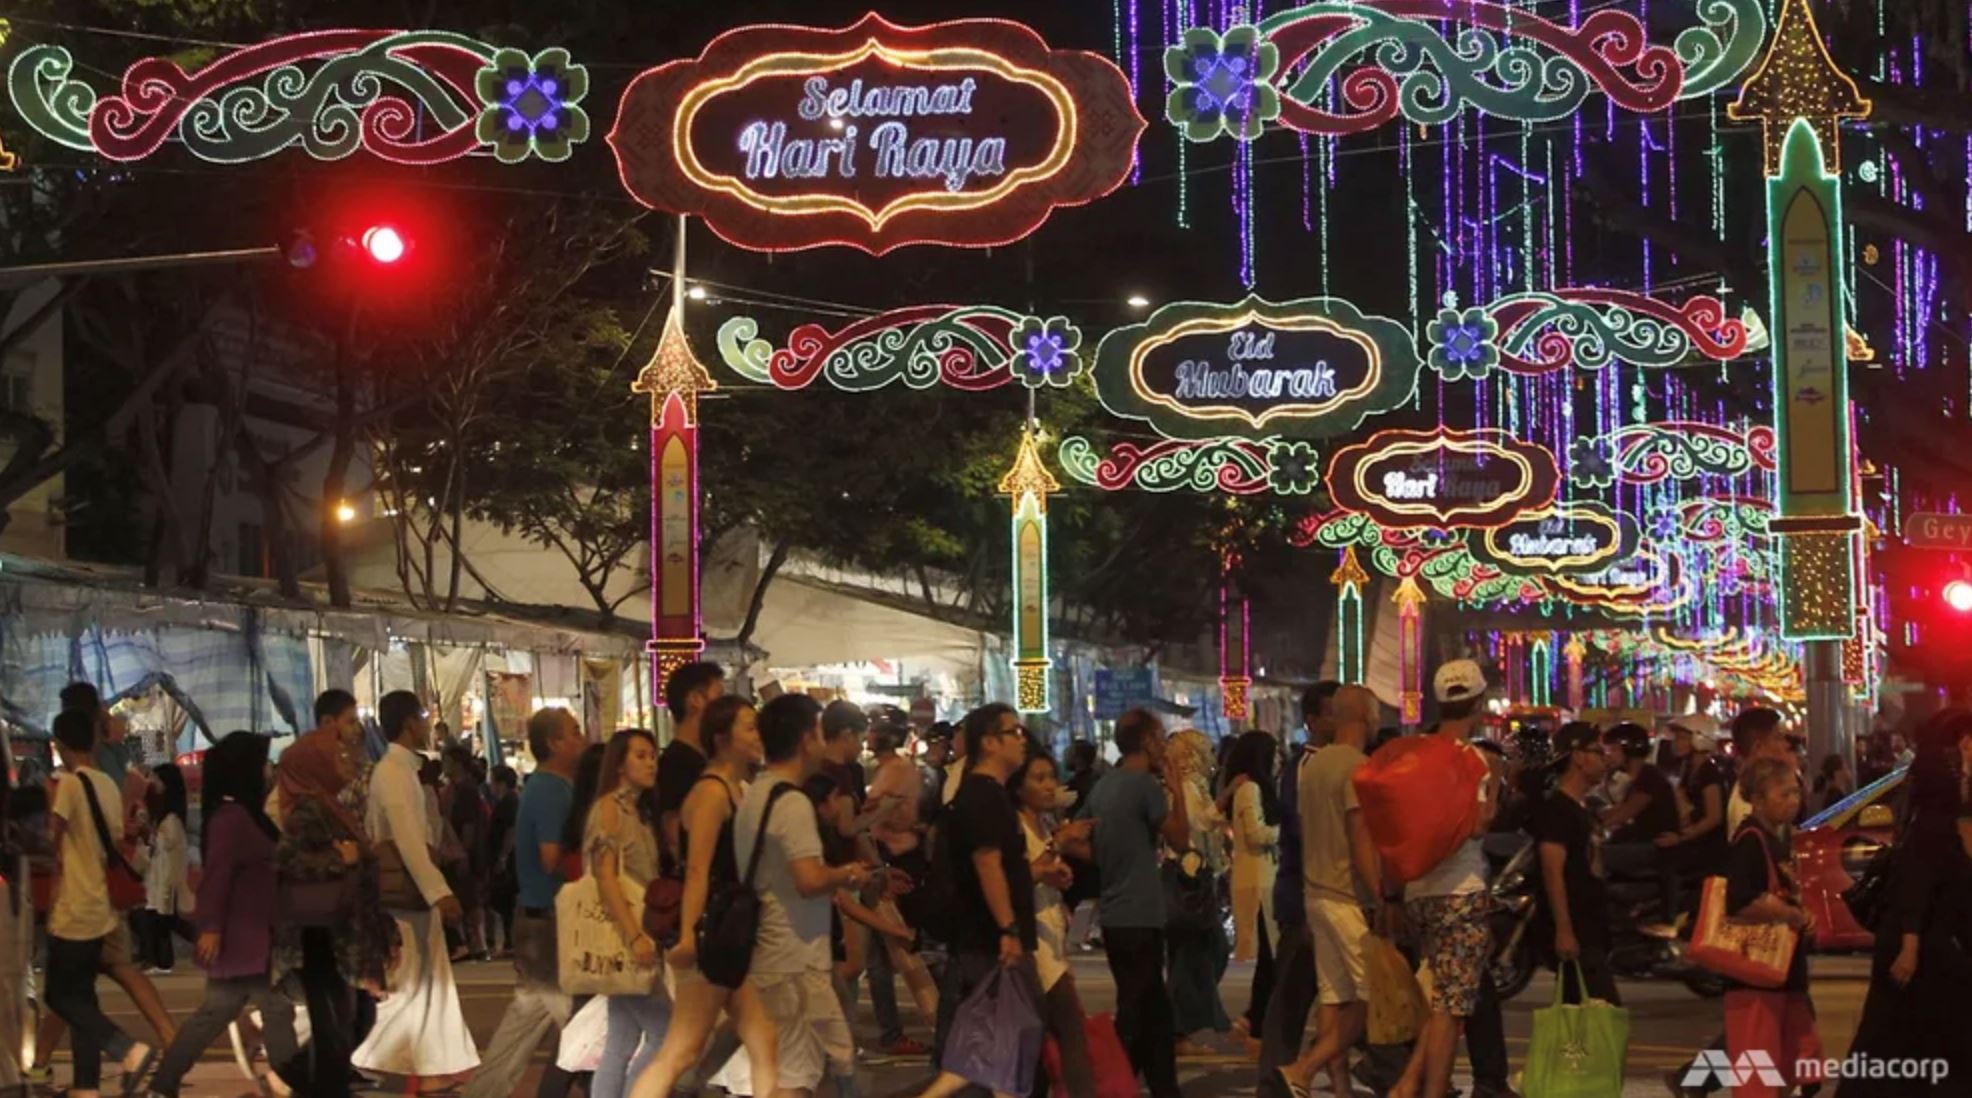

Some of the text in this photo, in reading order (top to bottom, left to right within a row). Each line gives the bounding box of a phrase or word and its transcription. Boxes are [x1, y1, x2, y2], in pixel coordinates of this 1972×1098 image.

[799, 76, 977, 119] Selamat
[739, 121, 1006, 192] Hari Raya
[1228, 331, 1275, 360] Eid
[1175, 360, 1336, 398] Mubarak
[1383, 471, 1438, 498] Hari
